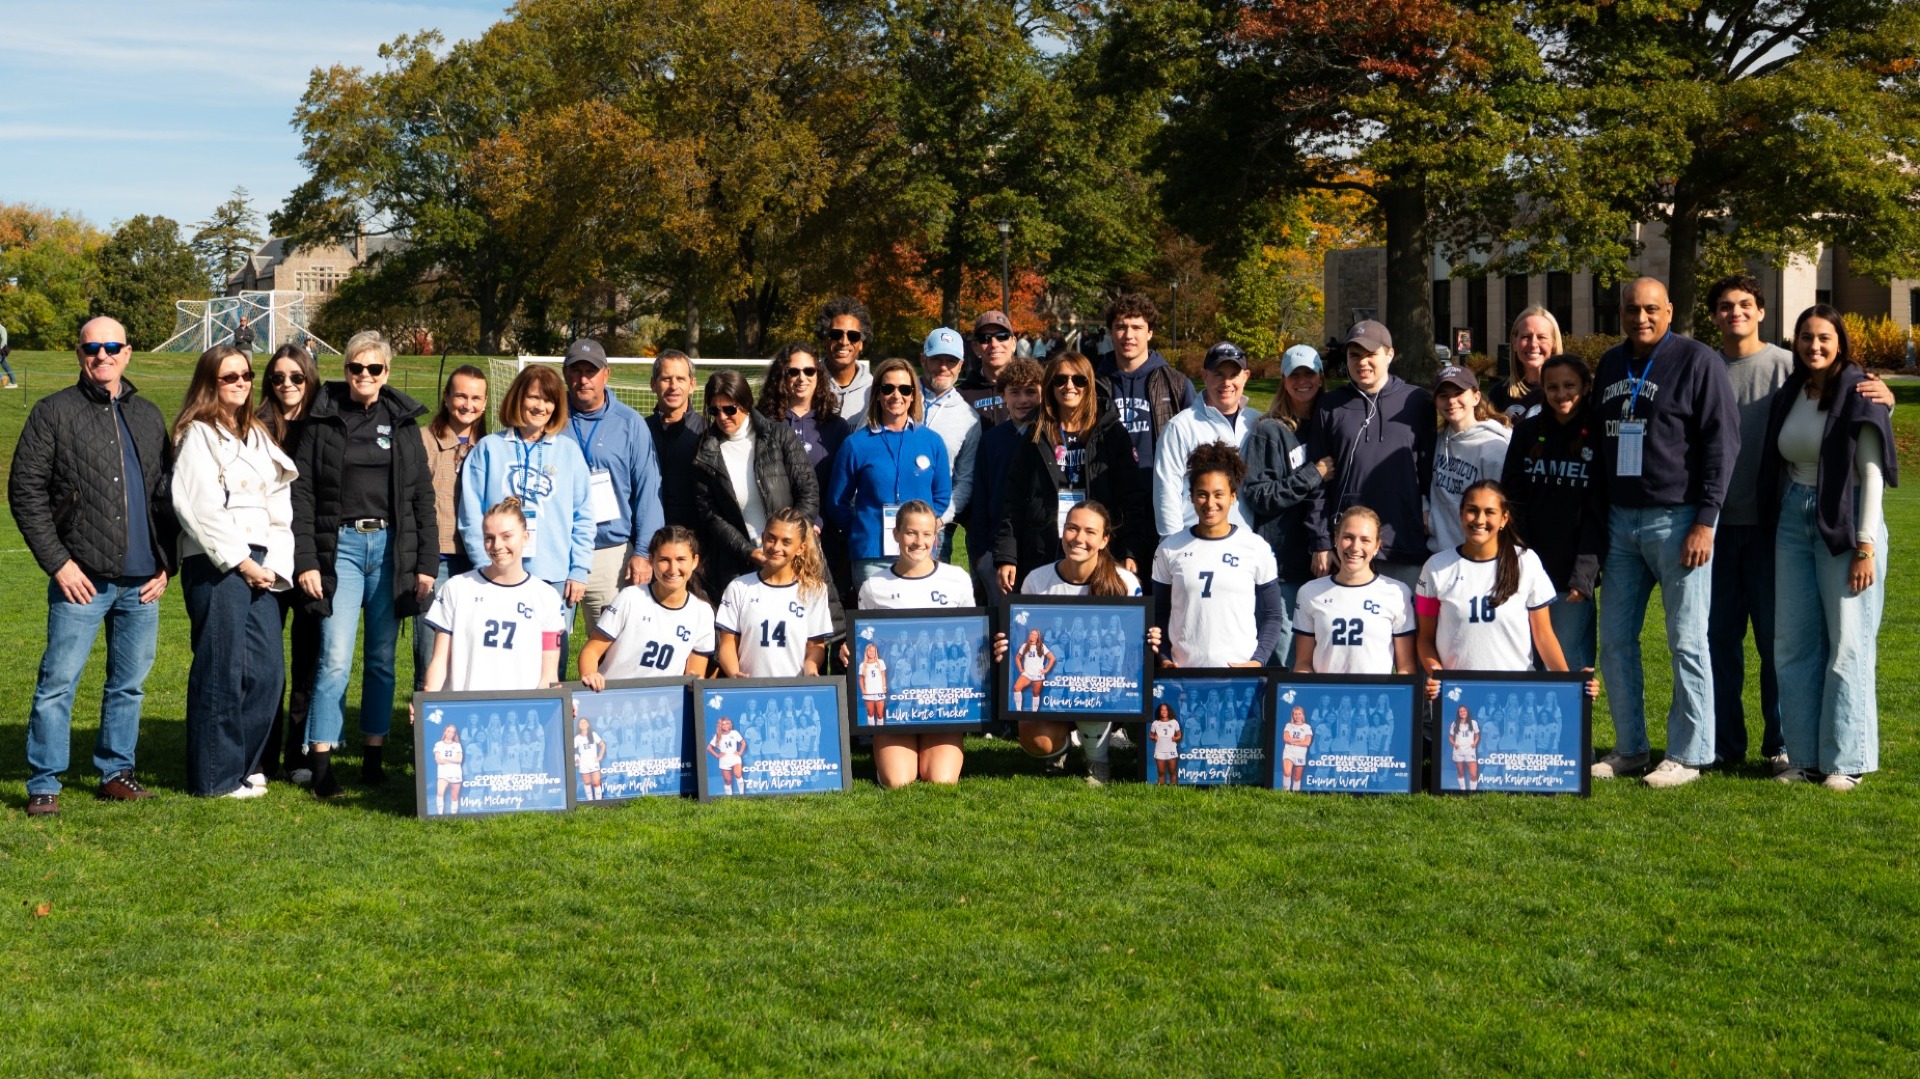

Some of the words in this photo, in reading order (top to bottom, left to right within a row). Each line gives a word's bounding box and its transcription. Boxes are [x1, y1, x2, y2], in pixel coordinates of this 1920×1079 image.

[1524, 458, 1590, 478] CAMEL
[1222, 553, 1239, 568] CC
[1198, 571, 1214, 598] 7
[930, 590, 949, 606] CC
[517, 602, 534, 620] CC
[788, 601, 805, 618] CC
[1363, 600, 1380, 615] CC
[1469, 595, 1497, 624] 16
[483, 618, 518, 650] 27
[676, 624, 692, 642] CC
[760, 618, 787, 648] 14
[1332, 617, 1364, 646] 22
[640, 640, 675, 671] 20
[912, 708, 934, 720] Kate
[937, 706, 968, 718] Tucker
[612, 758, 680, 768] CONNECTICUT
[754, 758, 825, 767] CONNECTICUT
[1490, 753, 1563, 761] CONNECTICUT
[601, 764, 646, 774] COLLEGE
[627, 769, 666, 777] SOCCER
[474, 773, 548, 782] CONNECTICUT
[491, 784, 532, 792] SOCCER
